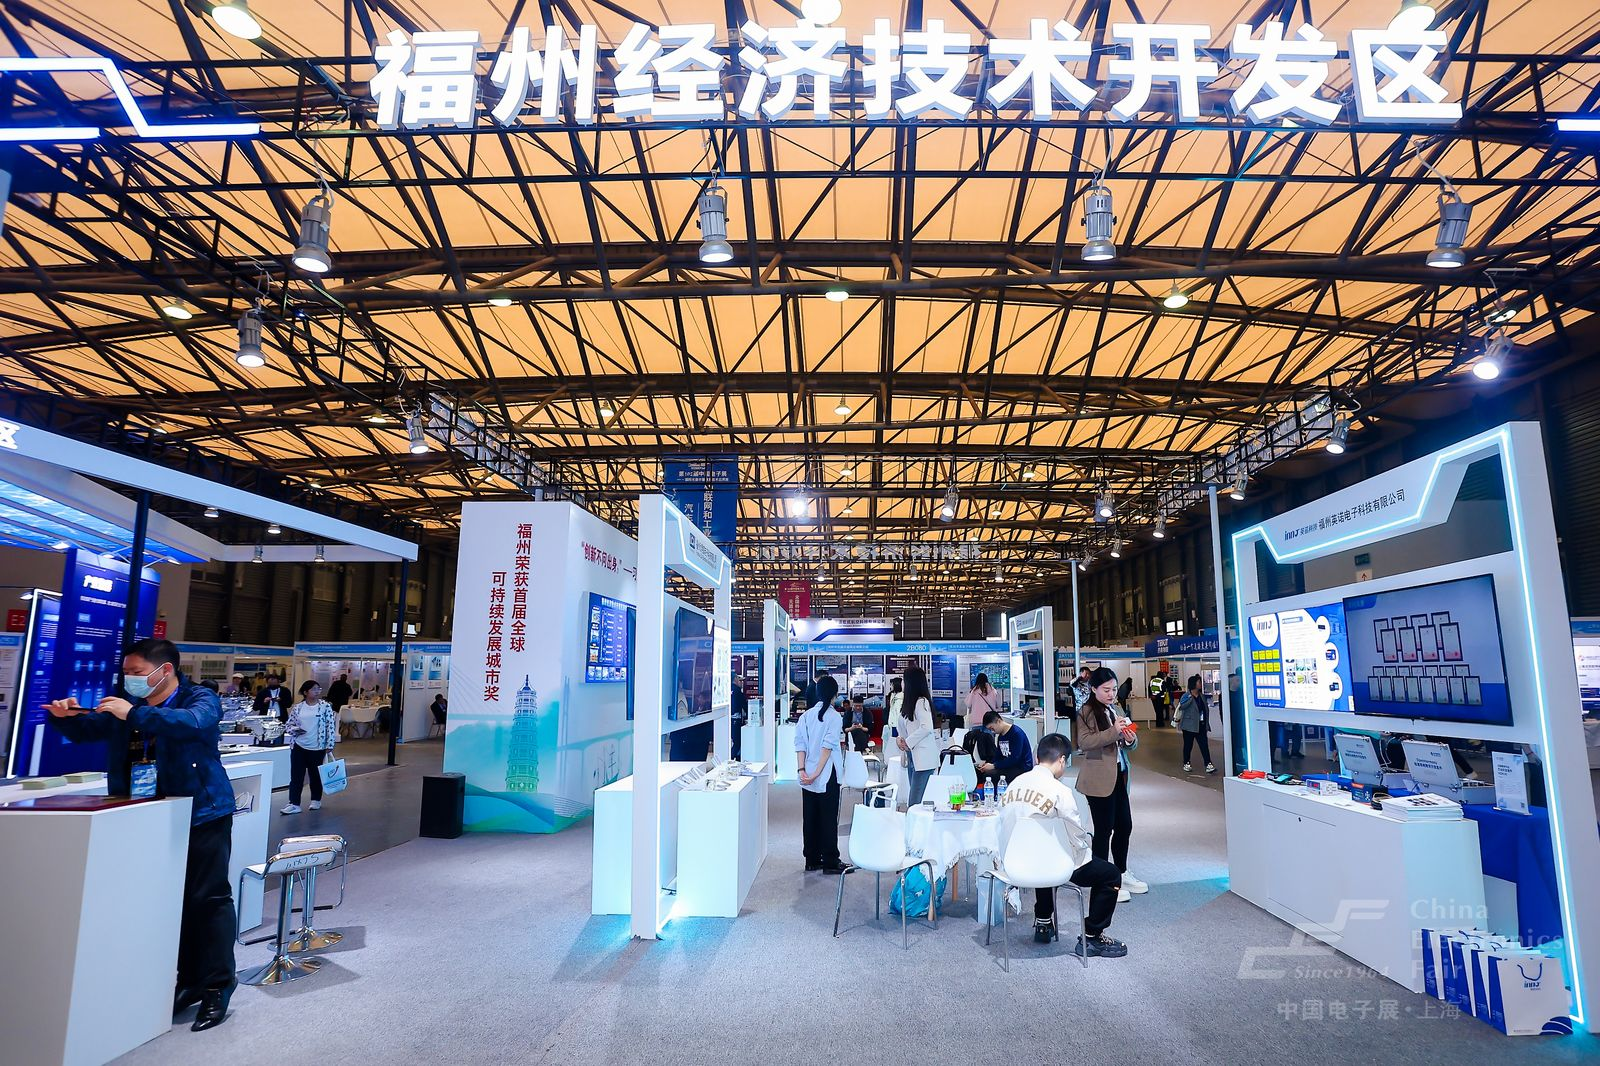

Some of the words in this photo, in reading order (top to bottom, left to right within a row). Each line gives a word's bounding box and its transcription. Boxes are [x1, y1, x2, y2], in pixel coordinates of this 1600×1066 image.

[370, 16, 1463, 129] 福州经济技术开发区
[1318, 488, 1405, 531] 福州英诺电子科技有限公司
[483, 571, 507, 702] 可持续发展城市奖
[509, 522, 533, 653] 福州荣获首届全球
